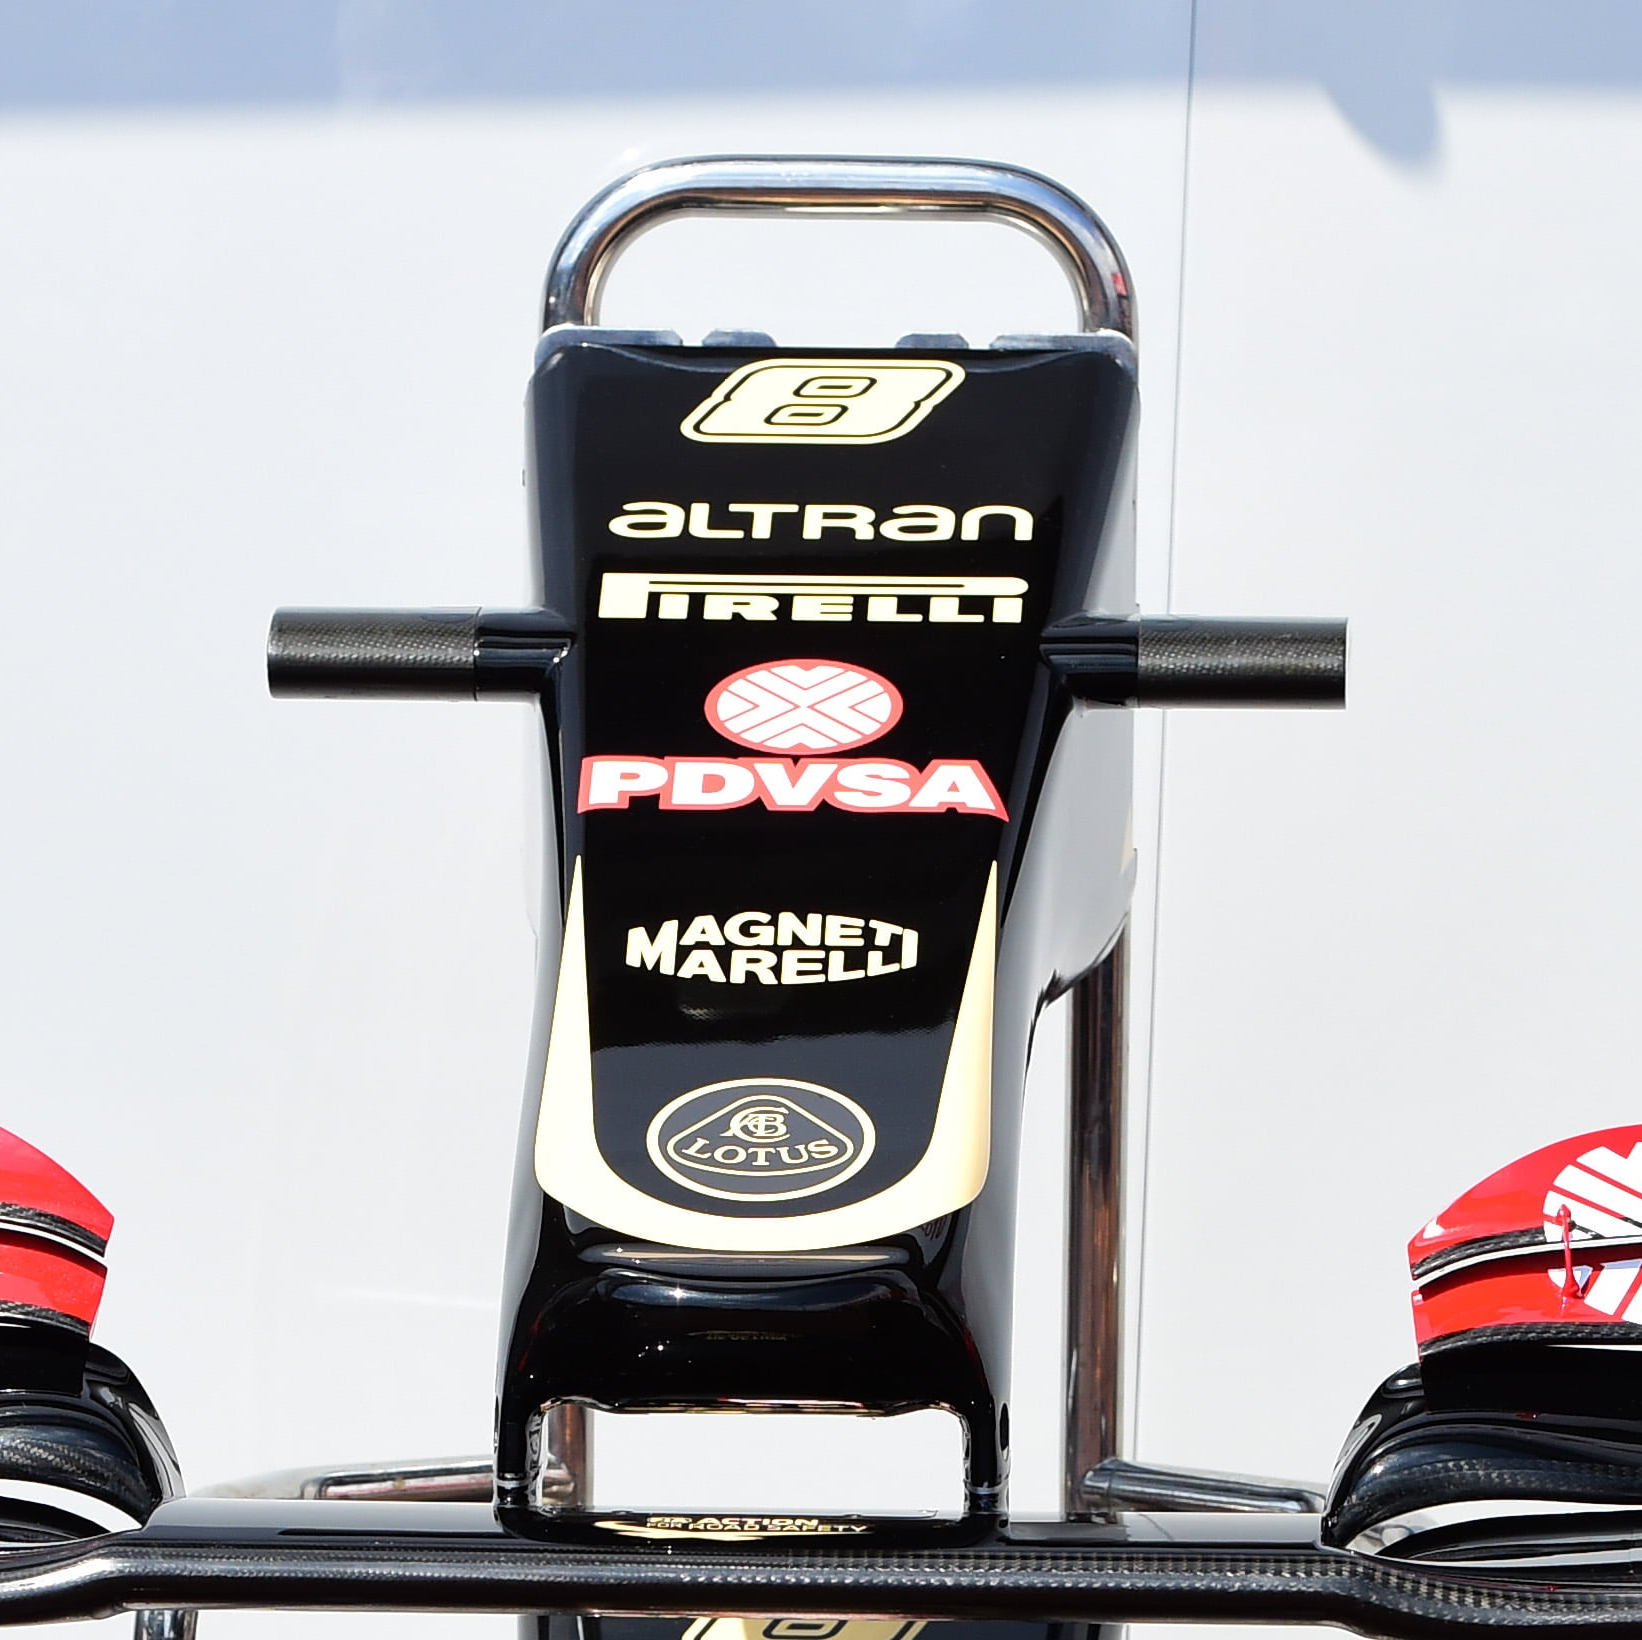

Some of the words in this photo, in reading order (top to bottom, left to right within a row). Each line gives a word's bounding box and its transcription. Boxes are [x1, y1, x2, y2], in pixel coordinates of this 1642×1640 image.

[681, 358, 966, 445] 8
[599, 573, 1029, 624] PIRELLI
[585, 760, 999, 812] PDVSA
[625, 911, 919, 968] MAGNETI
[625, 938, 919, 985] MARELLI
[681, 1137, 839, 1166] LOTUS
[697, 1517, 820, 1526] ACTION
[766, 1524, 868, 1533] SAFETY
